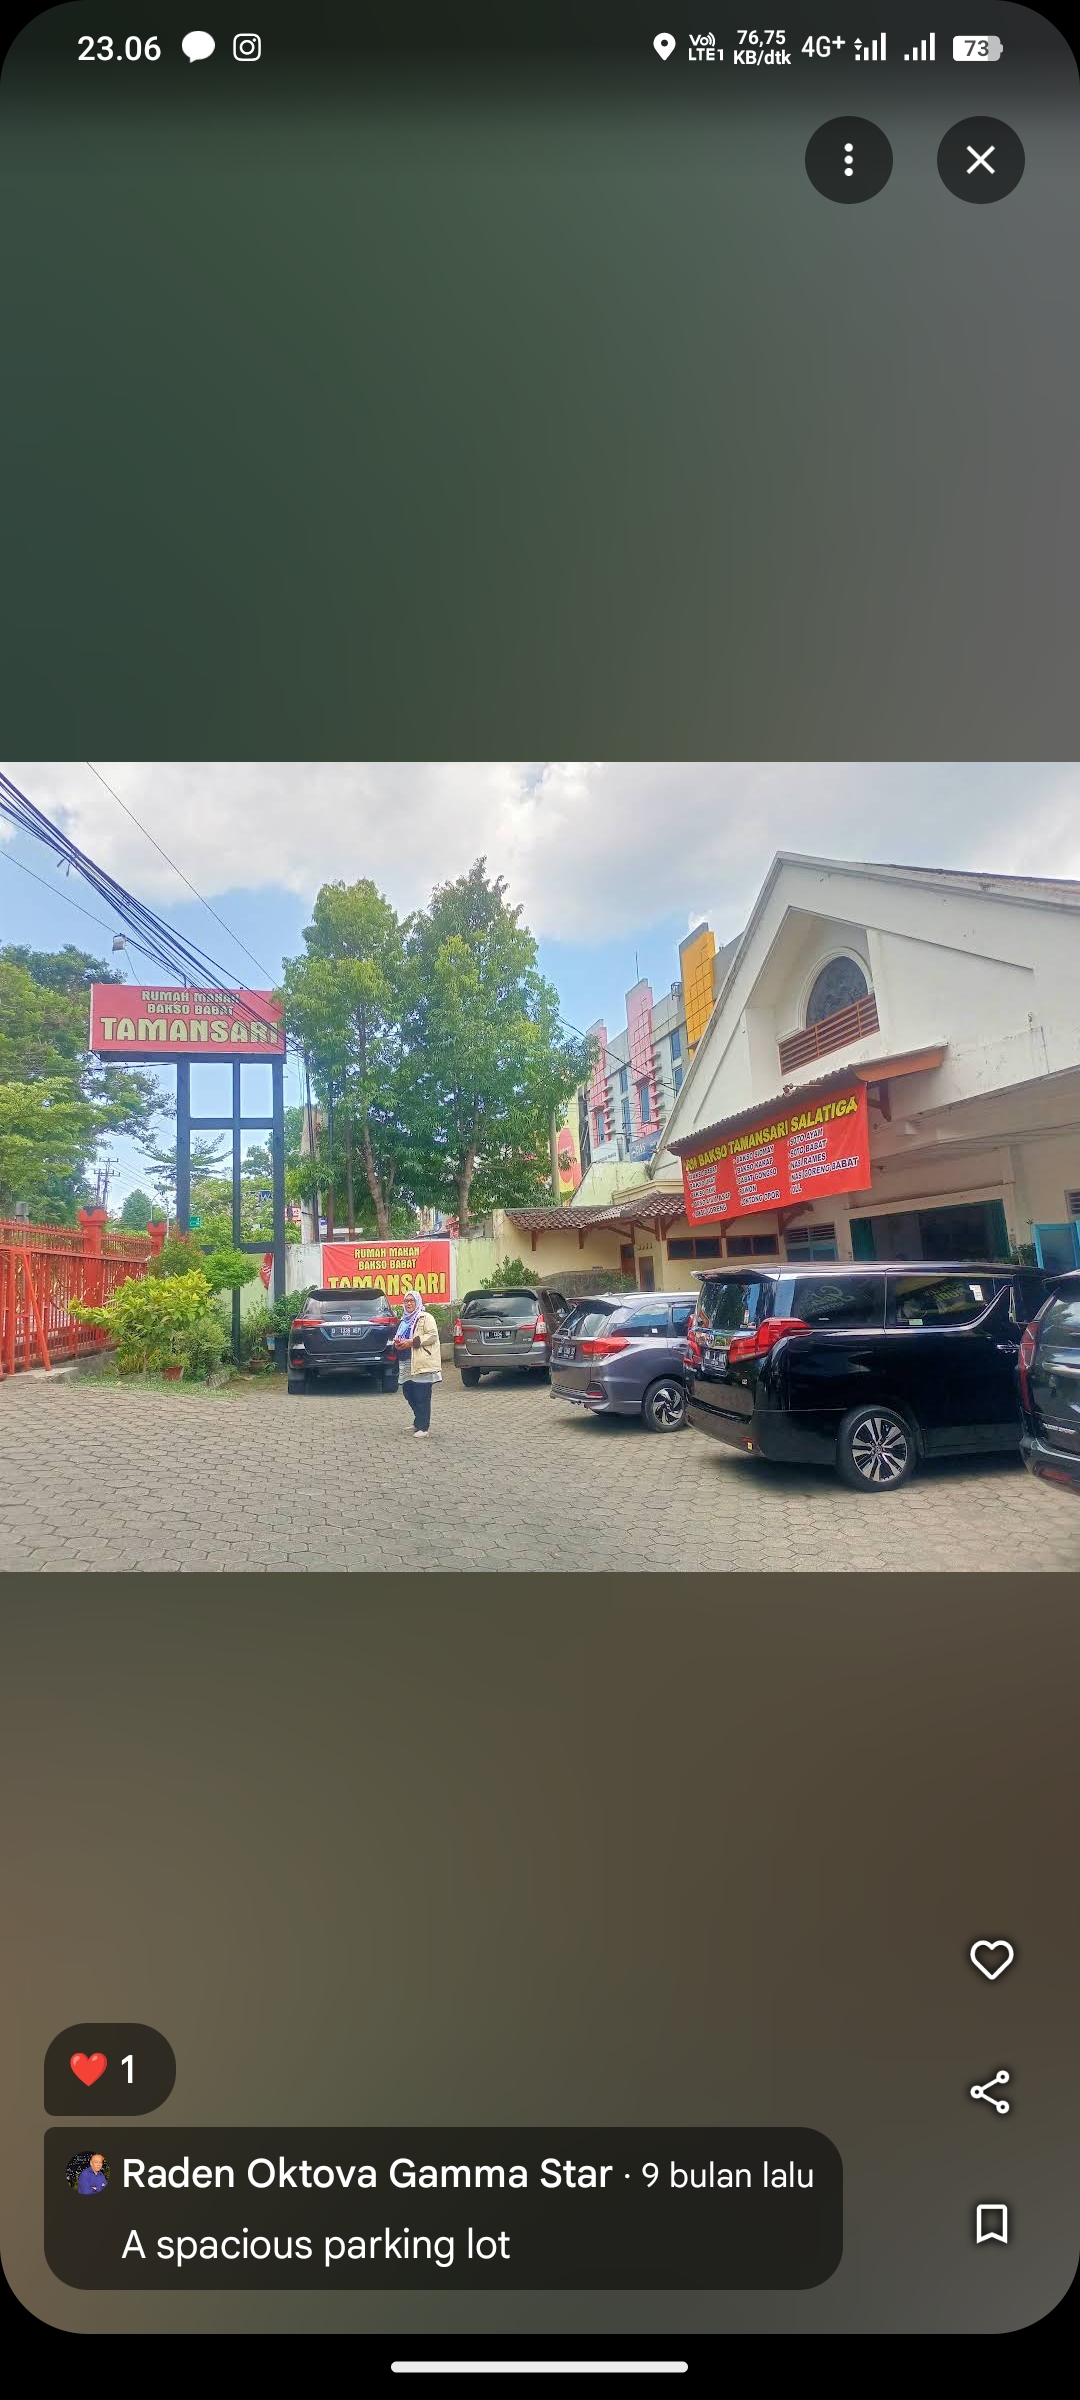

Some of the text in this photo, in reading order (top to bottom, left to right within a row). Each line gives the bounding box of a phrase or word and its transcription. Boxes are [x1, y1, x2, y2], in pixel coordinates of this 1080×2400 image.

[141, 990, 240, 1004] RUMAH MAKAN
[147, 1003, 234, 1016] BAKSO BABAT
[100, 1017, 280, 1044] TAMANSARI
[728, 1119, 789, 1154] TAMANSARI
[790, 1096, 859, 1133] SALATIGA
[805, 1139, 828, 1154] BABAT
[802, 1152, 827, 1167] RAMES
[803, 1164, 831, 1179] GORENG
[831, 1156, 859, 1171] BABAT
[354, 1246, 420, 1259] RUMAH MAKAN
[358, 1259, 417, 1271] BAKSO BABAT
[327, 1272, 447, 1296] TAMANSARI
